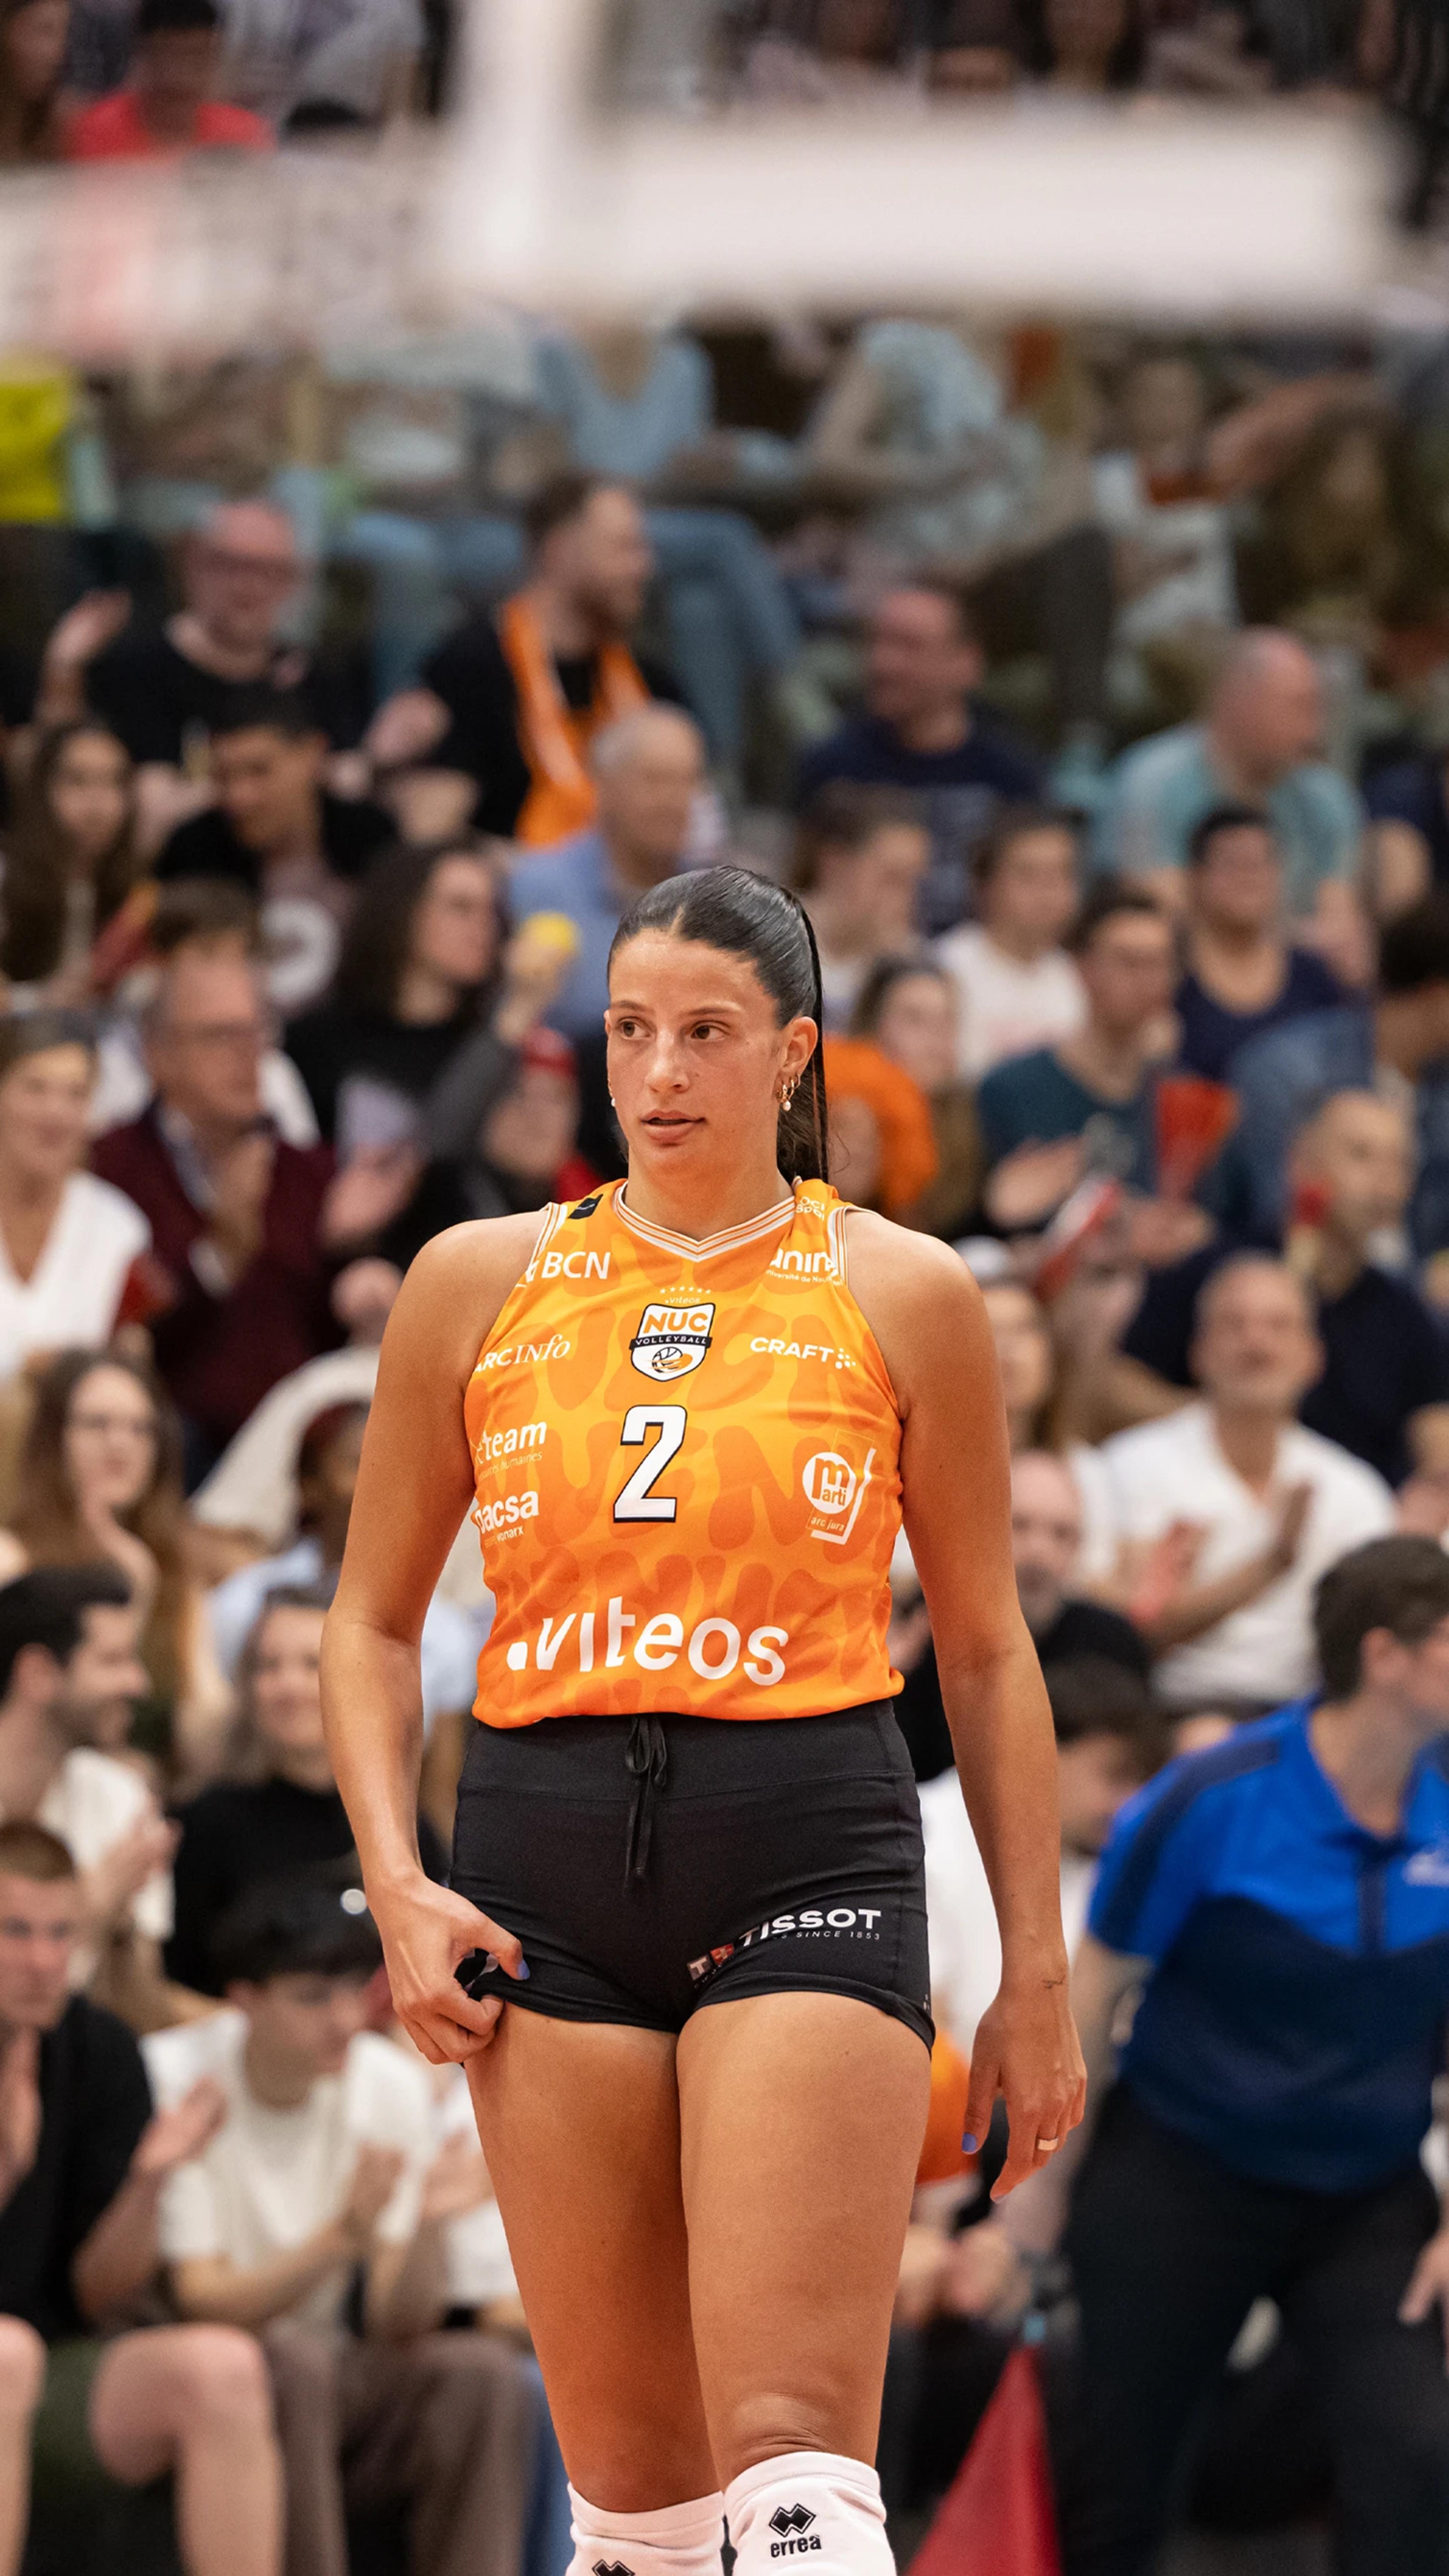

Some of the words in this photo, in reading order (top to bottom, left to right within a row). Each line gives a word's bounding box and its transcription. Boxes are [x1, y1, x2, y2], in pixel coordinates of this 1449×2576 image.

[541, 1251, 611, 1280] BCN
[643, 1312, 709, 1334] NUC
[635, 1336, 707, 1346] VOLLEYBALL
[749, 1337, 834, 1363] CRAFT
[613, 1404, 688, 1523] 2
[811, 1516, 826, 1527] arc
[826, 1519, 844, 1532] jura
[738, 1908, 881, 1947] TISSOT
[850, 1930, 880, 1940] 1853
